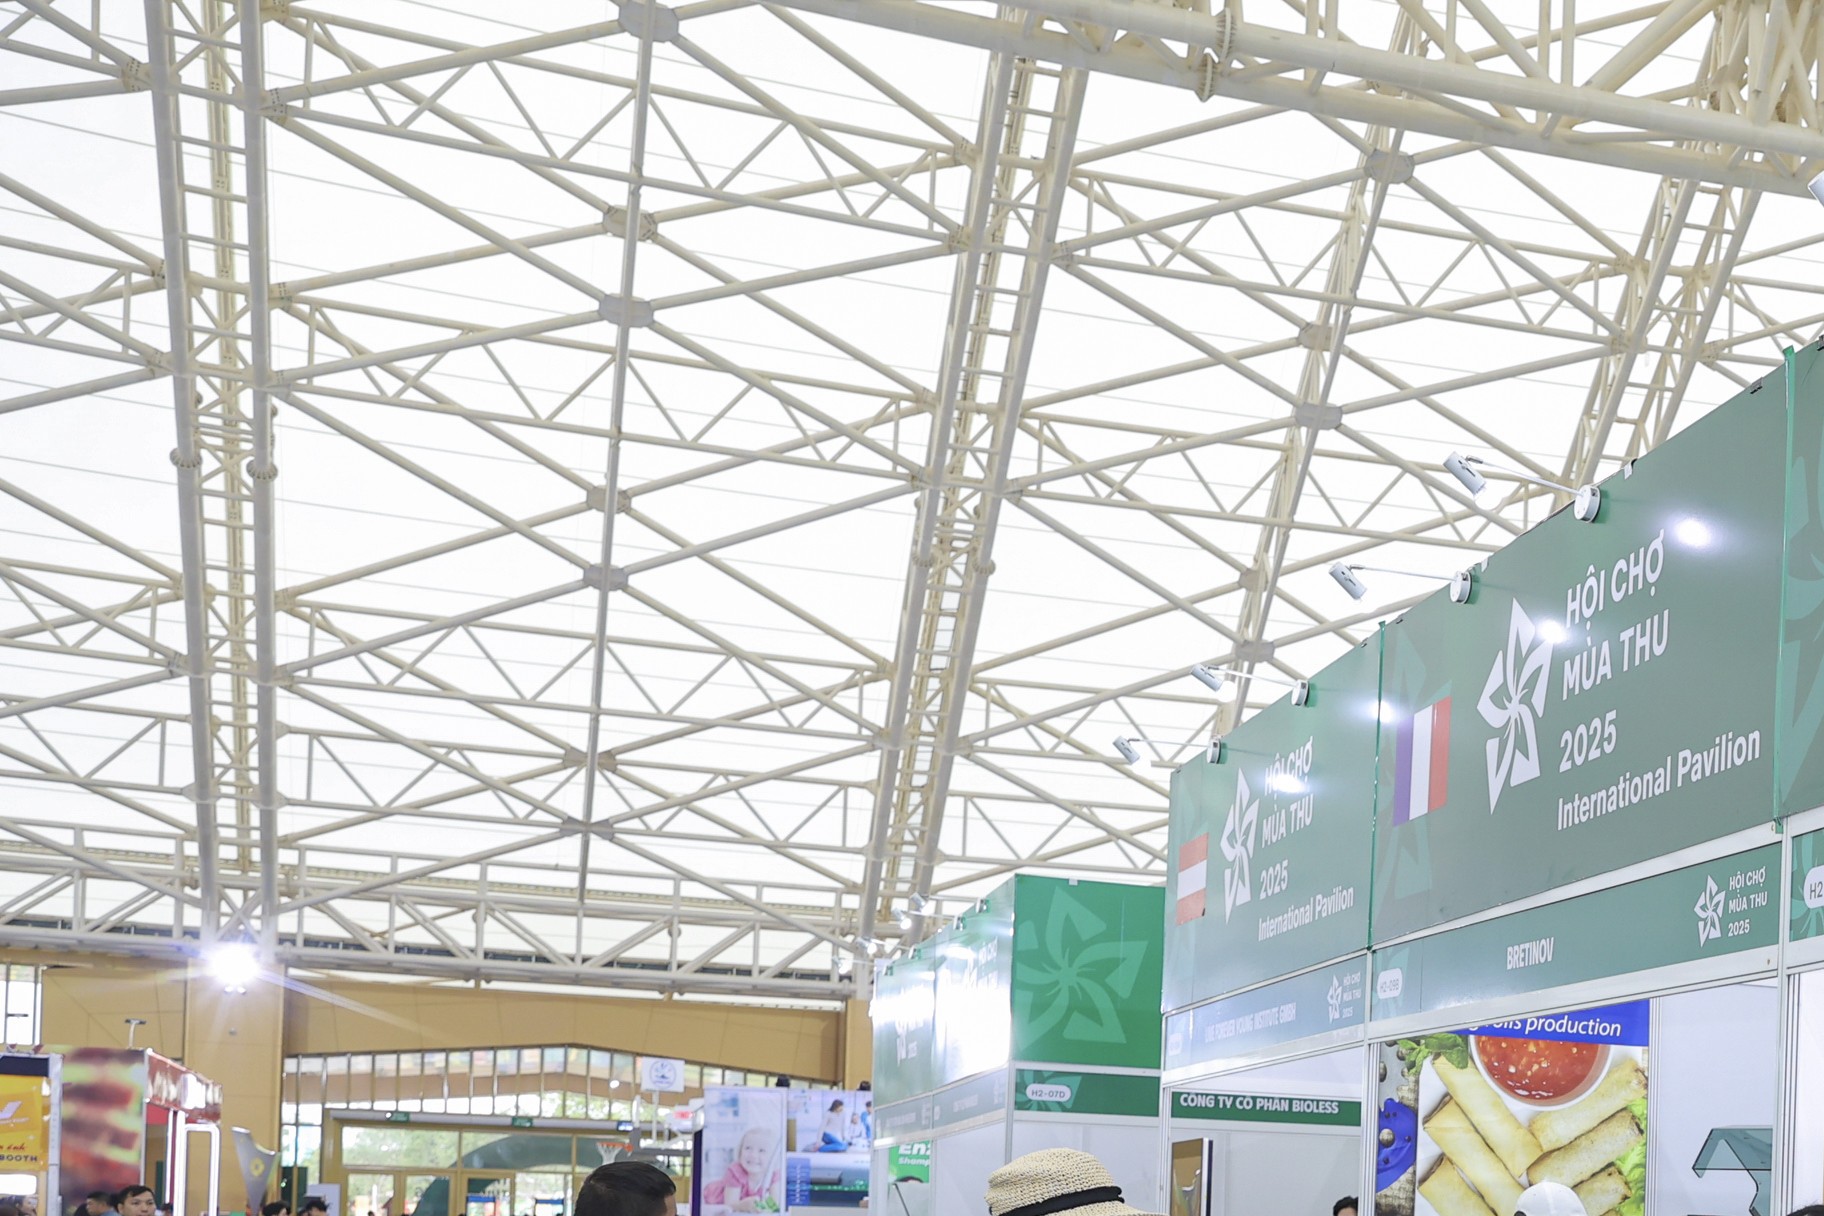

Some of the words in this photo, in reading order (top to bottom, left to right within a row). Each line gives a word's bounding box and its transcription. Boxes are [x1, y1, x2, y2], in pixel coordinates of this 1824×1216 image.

[1566, 564, 1605, 631] HỘI
[1611, 529, 1665, 603] CHỢ
[1563, 636, 1612, 700] MÙA
[1620, 609, 1669, 672] THU
[1559, 709, 1617, 773] 2025
[1557, 755, 1670, 831] International
[1677, 730, 1761, 787] Pavilion
[1262, 804, 1286, 848] MÙA
[1290, 794, 1313, 833] THU
[1259, 859, 1288, 900] 2025
[1729, 871, 1745, 893] HỘI
[1746, 866, 1766, 887] CHỢ
[1258, 897, 1312, 941] International
[1315, 886, 1353, 920] Pavilion
[1729, 894, 1747, 914] MÙA
[1750, 892, 1767, 908] THU
[1728, 919, 1750, 937] 2025
[1507, 937, 1554, 970] BRETINOV
[1525, 1015, 1621, 1036] production
[1031, 1089, 1065, 1099] H2-07D
[1292, 1100, 1339, 1114] BIOLESS
